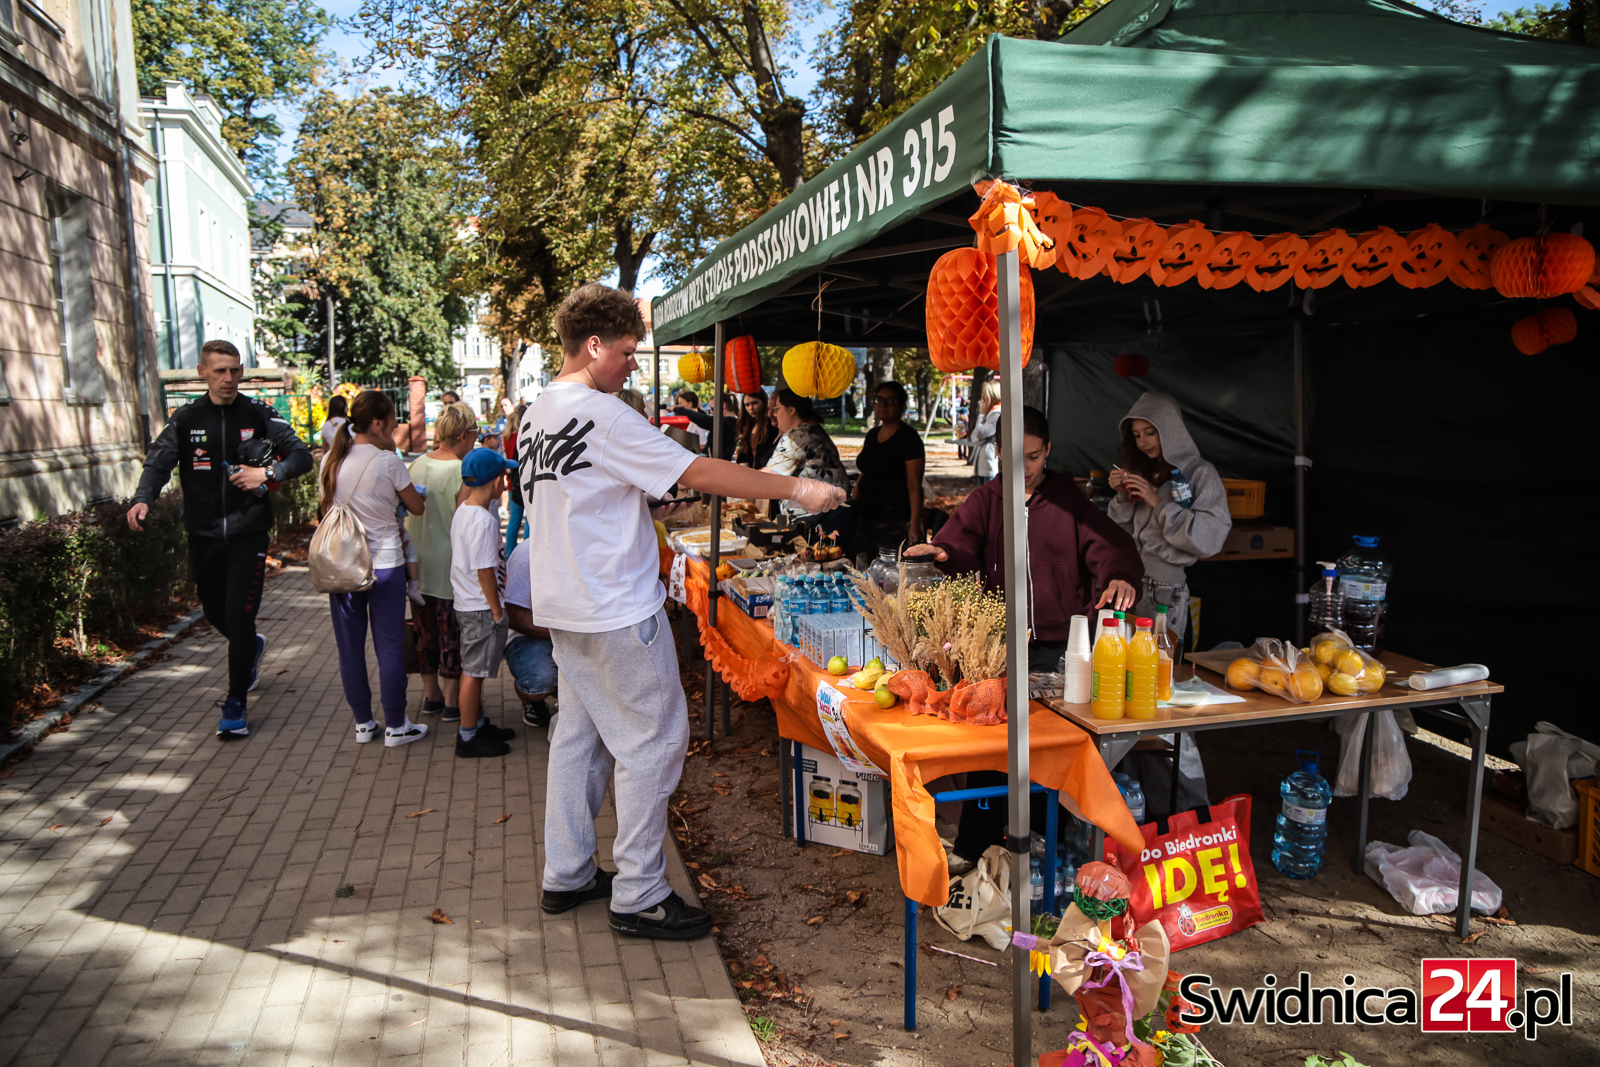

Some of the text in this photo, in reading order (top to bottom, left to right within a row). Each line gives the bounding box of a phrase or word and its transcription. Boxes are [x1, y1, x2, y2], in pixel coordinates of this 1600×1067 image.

[689, 273, 704, 312] PRZY
[734, 173, 850, 286] PODSTAWOWEJ
[856, 146, 894, 222] NR
[903, 104, 956, 198] 315
[1141, 825, 1237, 862] Do Biedronki
[1143, 843, 1247, 910] IDĘ!
[1195, 910, 1229, 923] Biedronka
